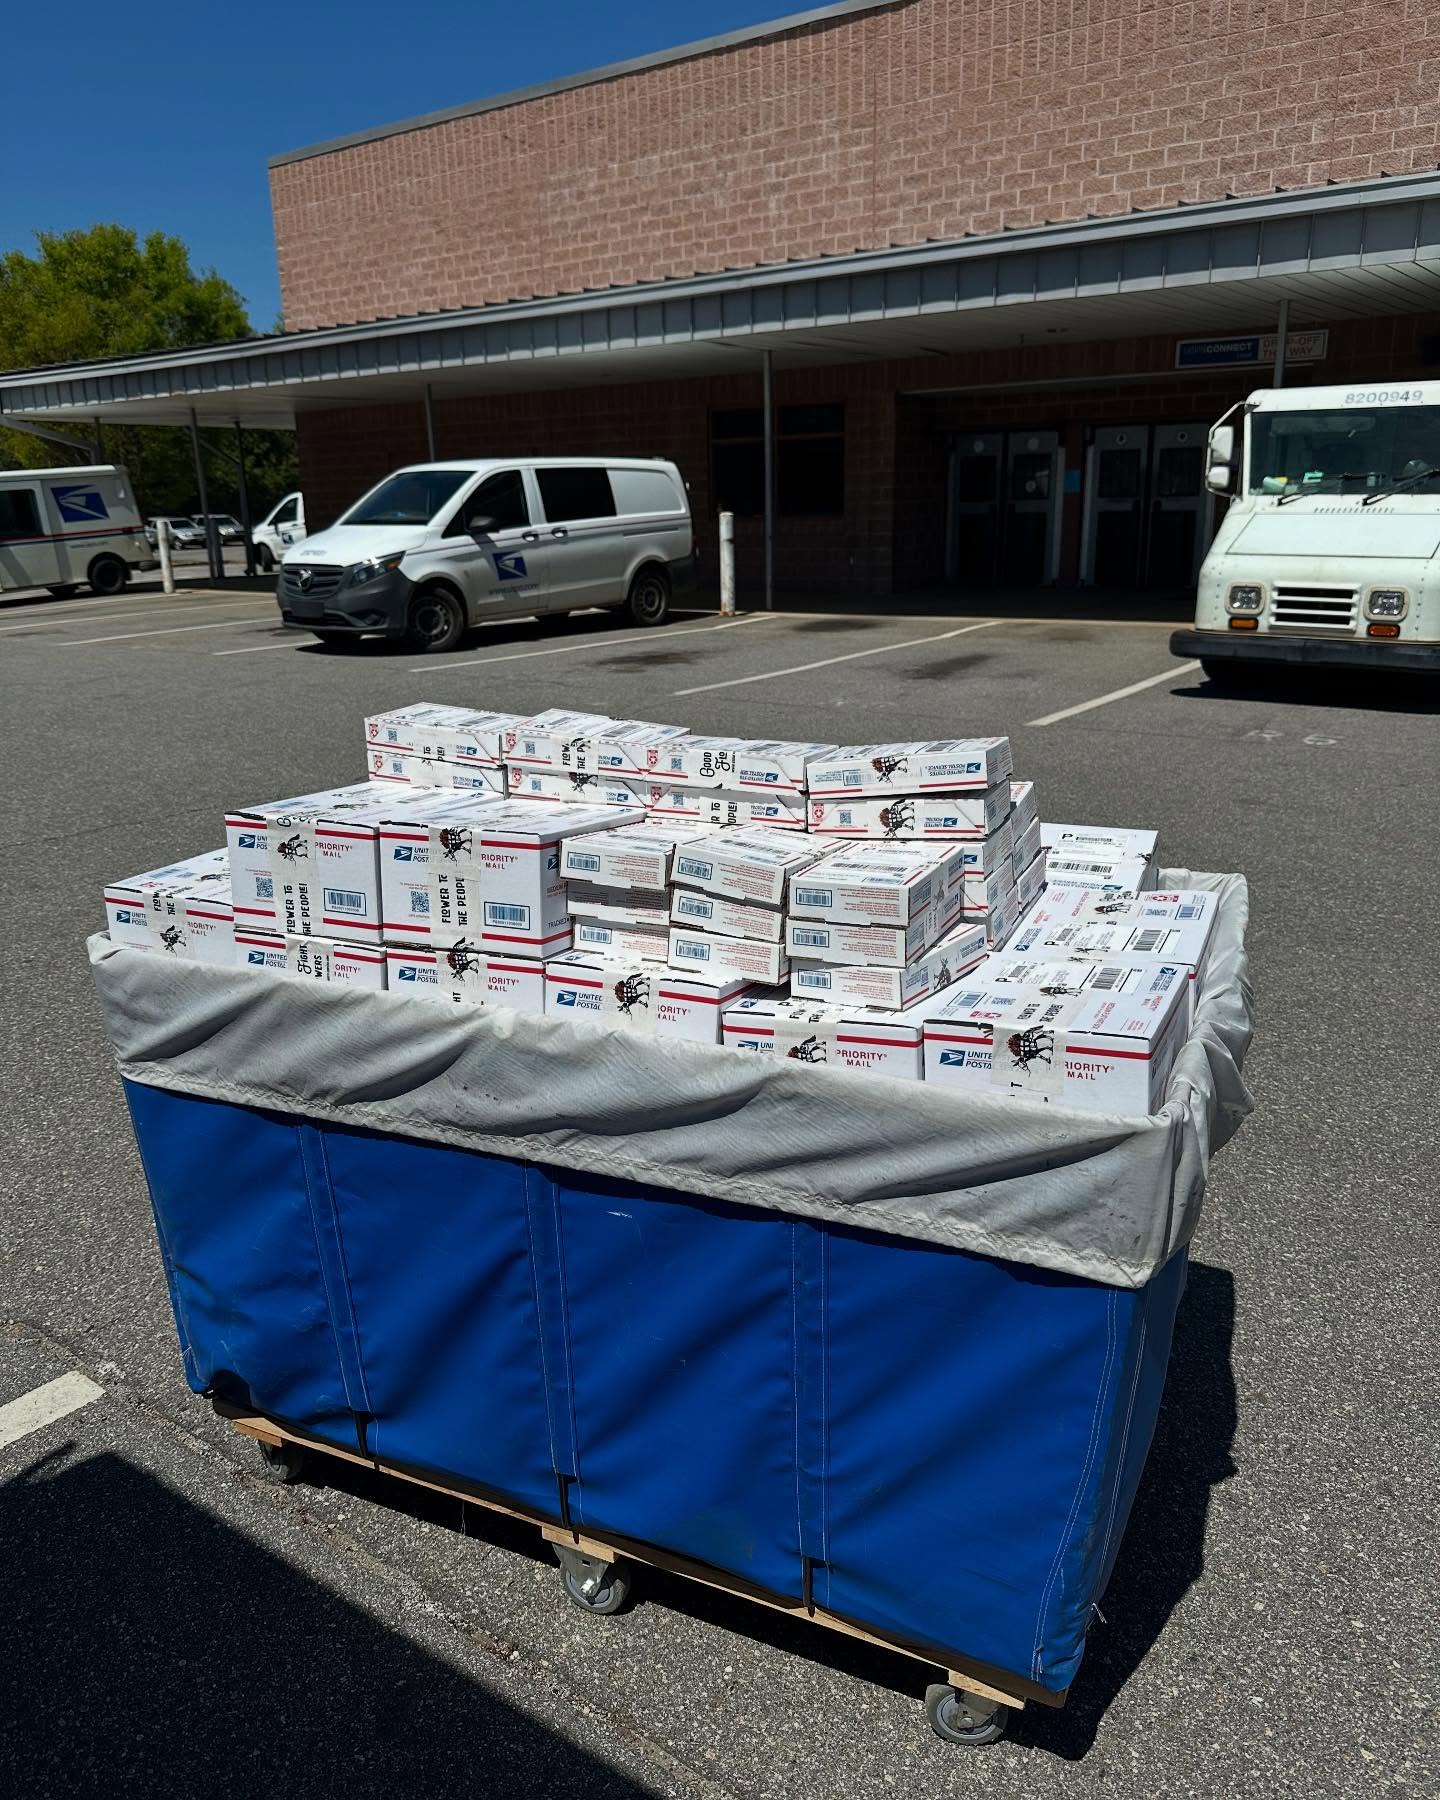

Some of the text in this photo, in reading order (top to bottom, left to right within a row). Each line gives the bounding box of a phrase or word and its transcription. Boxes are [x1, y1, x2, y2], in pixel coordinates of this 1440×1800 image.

[1345, 390, 1423, 404] 8200949
[562, 745, 571, 766] FLOW
[728, 802, 738, 824] OPLE!
[412, 855, 430, 863] POST
[481, 854, 515, 863] RIORITY
[152, 892, 162, 912] FLOW
[299, 883, 312, 917] PEOPLE!
[456, 877, 468, 926] THE PEOPL
[166, 902, 176, 916] THE
[284, 884, 296, 933] FLOWER TO
[440, 888, 452, 924] FLOWER
[188, 922, 215, 930] RIORITY
[336, 964, 357, 973] ORITY
[489, 976, 516, 986] IORITY
[658, 1005, 688, 1015] IORITY
[967, 1051, 992, 1060] UNITE
[846, 1059, 872, 1068] MAIL
[966, 1060, 992, 1070] POSTA
[1065, 1061, 1109, 1074] RIORITY
[1067, 1071, 1096, 1080] MAIL
